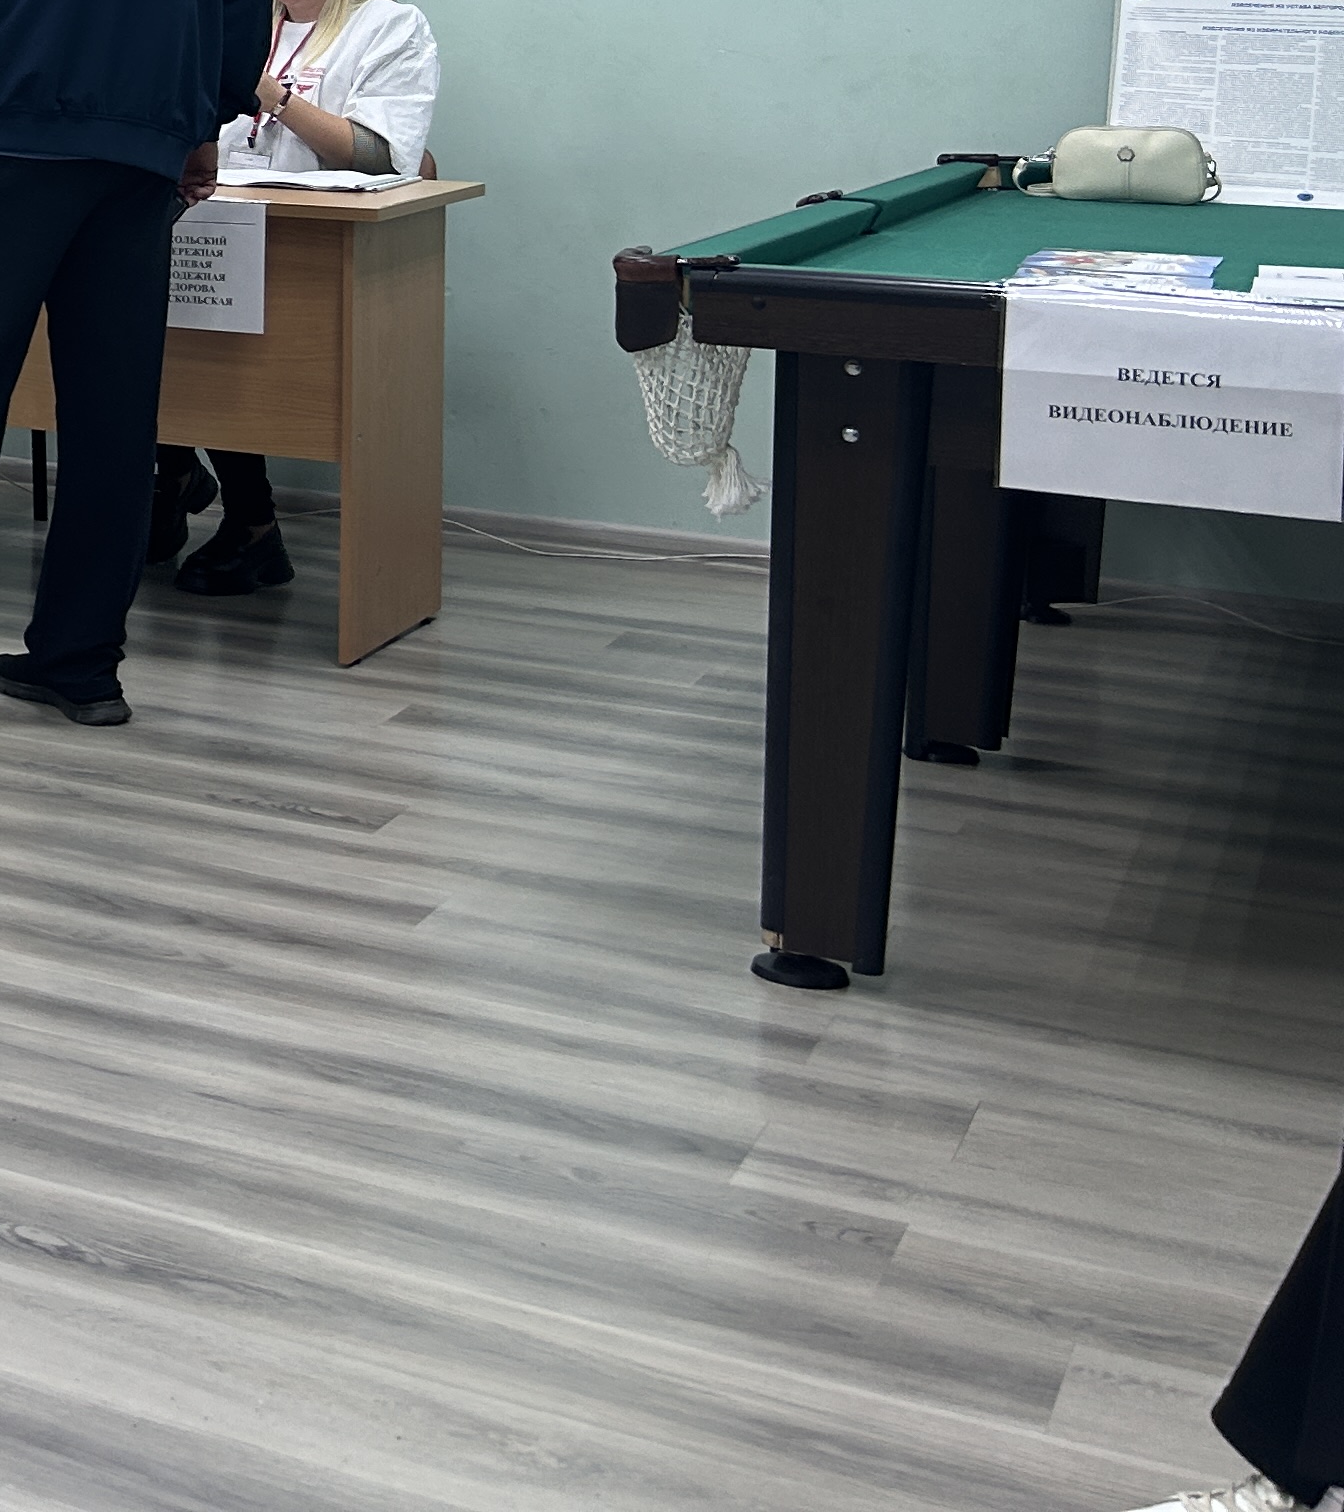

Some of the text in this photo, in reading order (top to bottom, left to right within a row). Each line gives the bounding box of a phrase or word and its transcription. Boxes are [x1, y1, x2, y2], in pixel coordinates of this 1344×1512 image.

[170, 283, 216, 293] ДОРОВА
[1117, 367, 1222, 389] ВЕДЕТСЯ
[1048, 404, 1293, 437] ВИДЕОНАБЛЮДЕНИЕ
